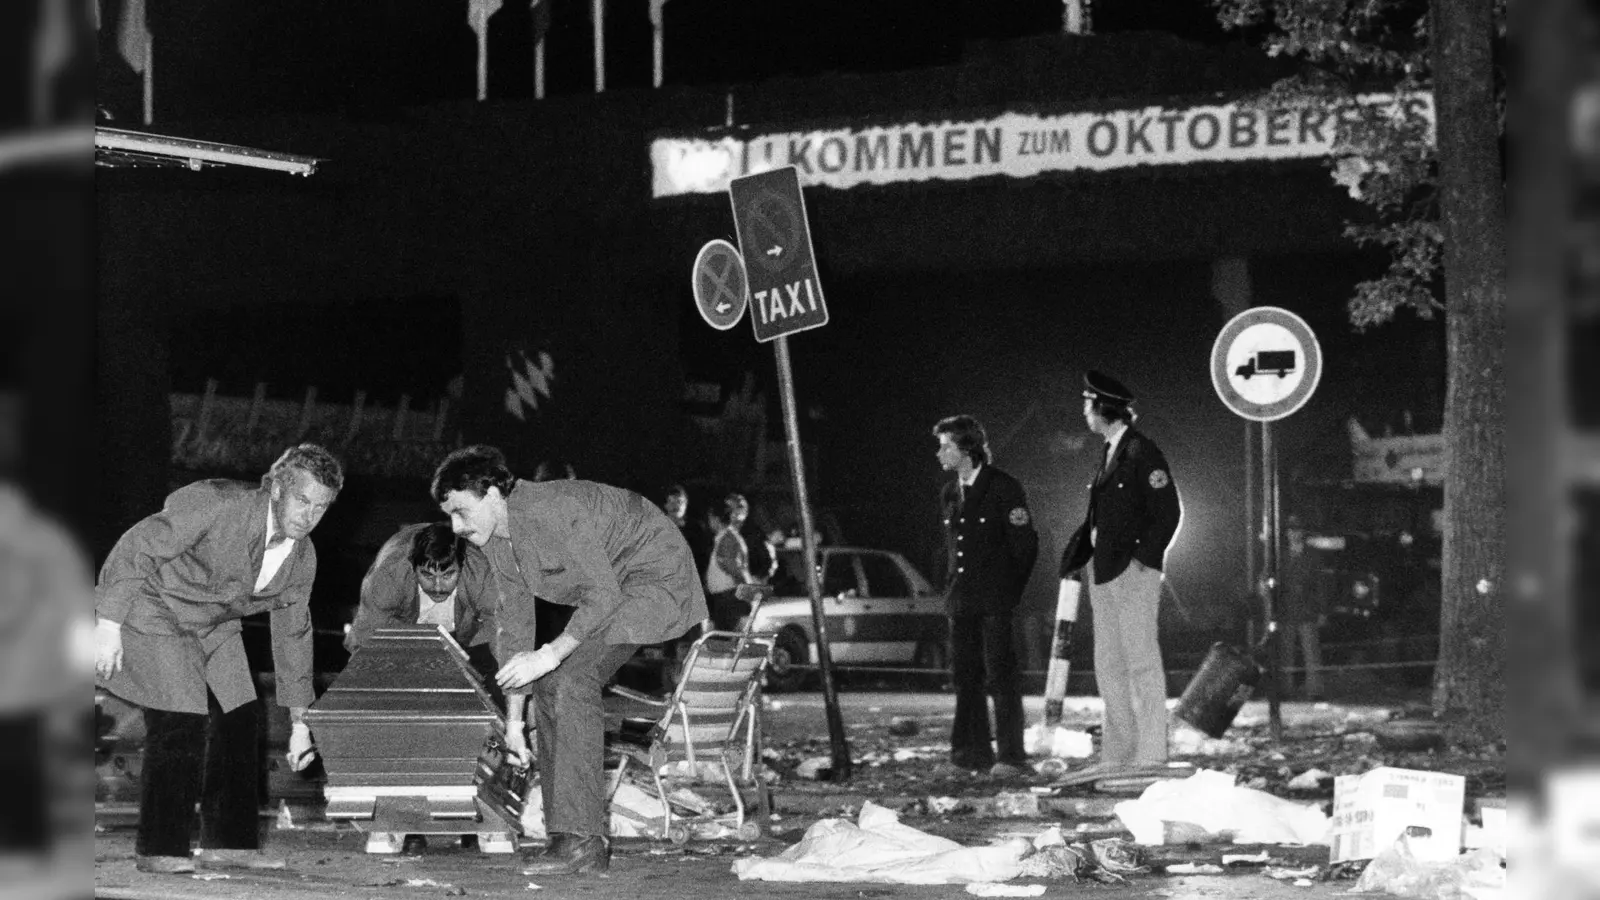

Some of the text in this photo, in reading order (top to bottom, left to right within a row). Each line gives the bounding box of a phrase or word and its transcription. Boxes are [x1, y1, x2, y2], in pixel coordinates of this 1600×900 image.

[681, 99, 1429, 178] KOMMEN ZUM OKTOBERS
[754, 278, 817, 324] TAXI
